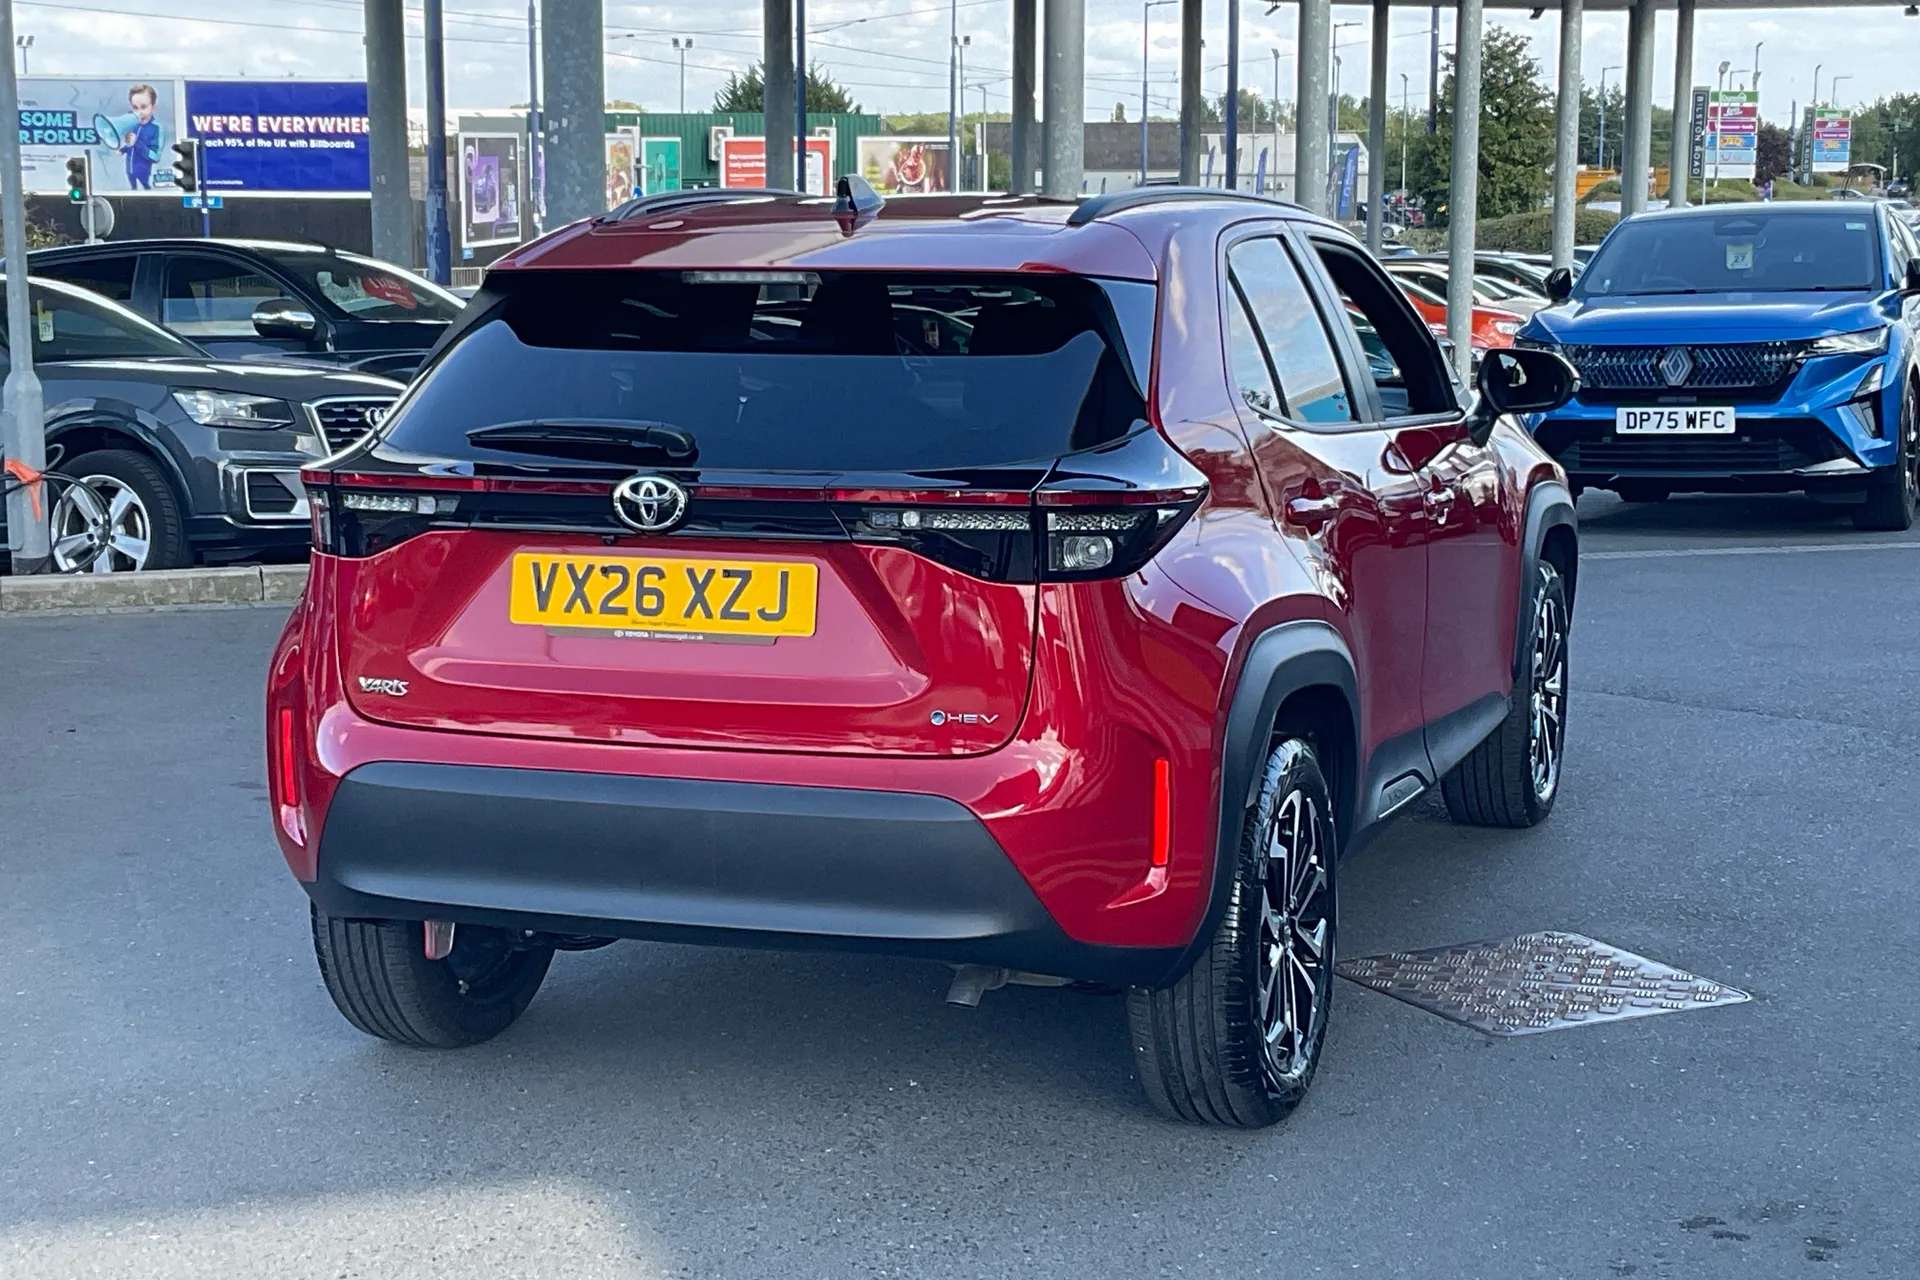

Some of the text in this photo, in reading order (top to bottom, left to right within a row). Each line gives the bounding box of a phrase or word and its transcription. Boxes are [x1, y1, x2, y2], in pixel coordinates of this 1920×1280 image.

[20, 111, 73, 128] SOME
[192, 115, 254, 133] WE'RE
[33, 129, 72, 144] FOR
[72, 129, 97, 144] US
[225, 138, 244, 148] 95%
[256, 138, 272, 148] the
[273, 139, 288, 148] UK
[288, 139, 309, 149] with
[309, 139, 356, 149] Billboards
[1625, 410, 1726, 430] DP75 WFC
[531, 561, 790, 623] VX26 XZJ
[946, 712, 1000, 724] HEV
